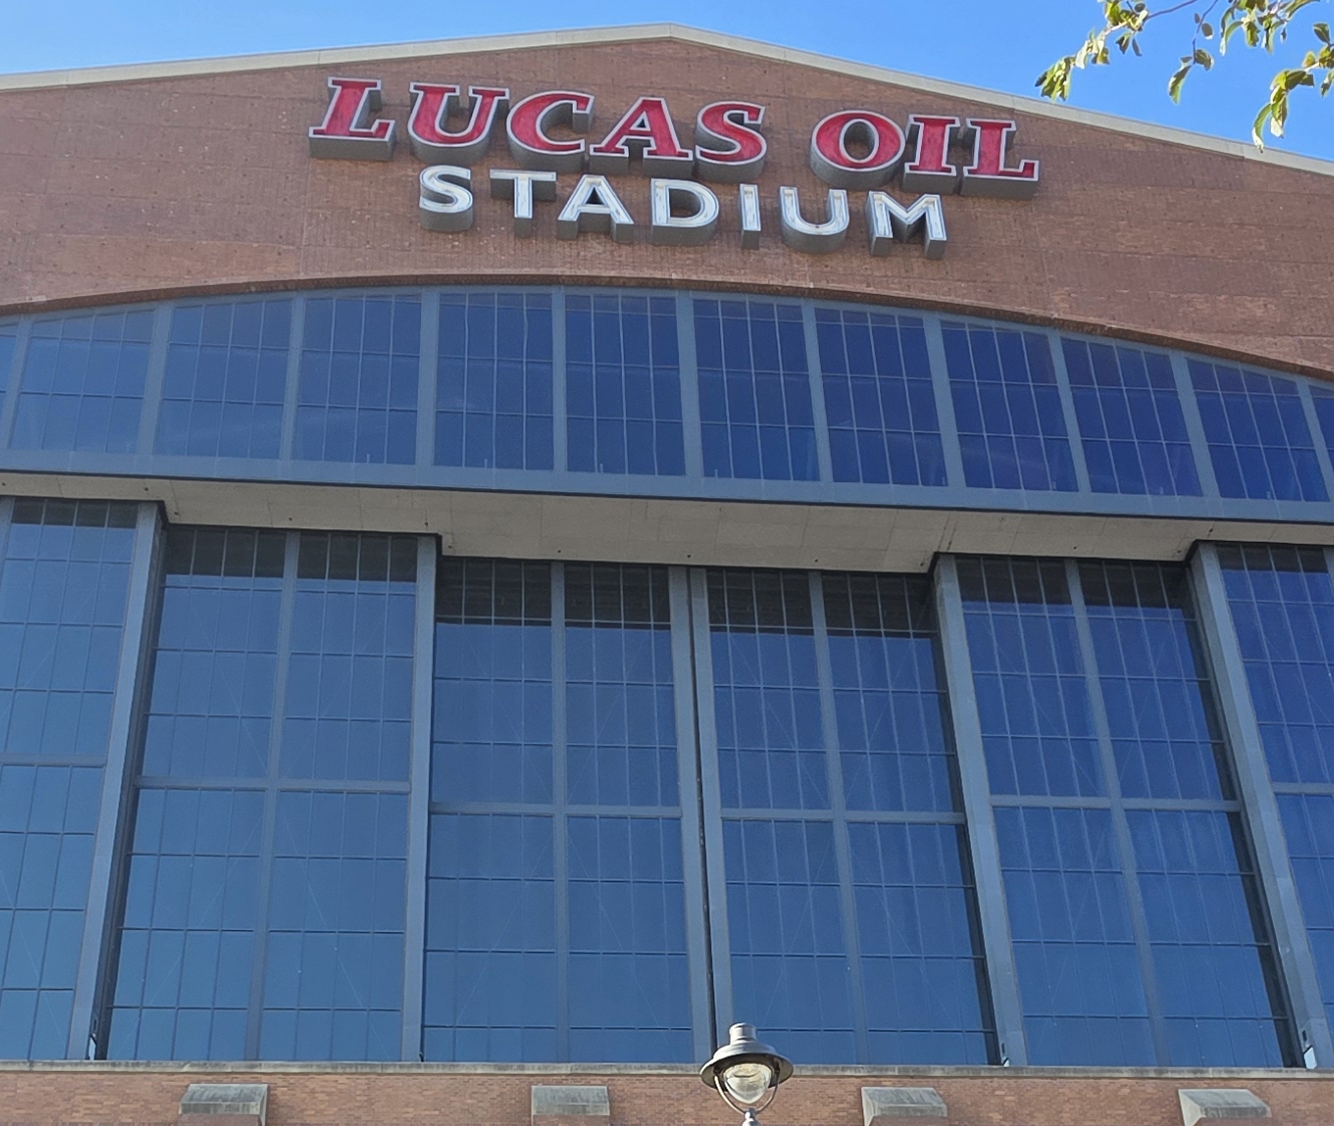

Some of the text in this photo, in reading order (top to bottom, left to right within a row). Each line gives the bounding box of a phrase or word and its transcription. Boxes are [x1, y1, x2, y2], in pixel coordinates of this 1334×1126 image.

[309, 76, 1040, 188] LUCAS OIL
[419, 165, 946, 249] STADIUM
